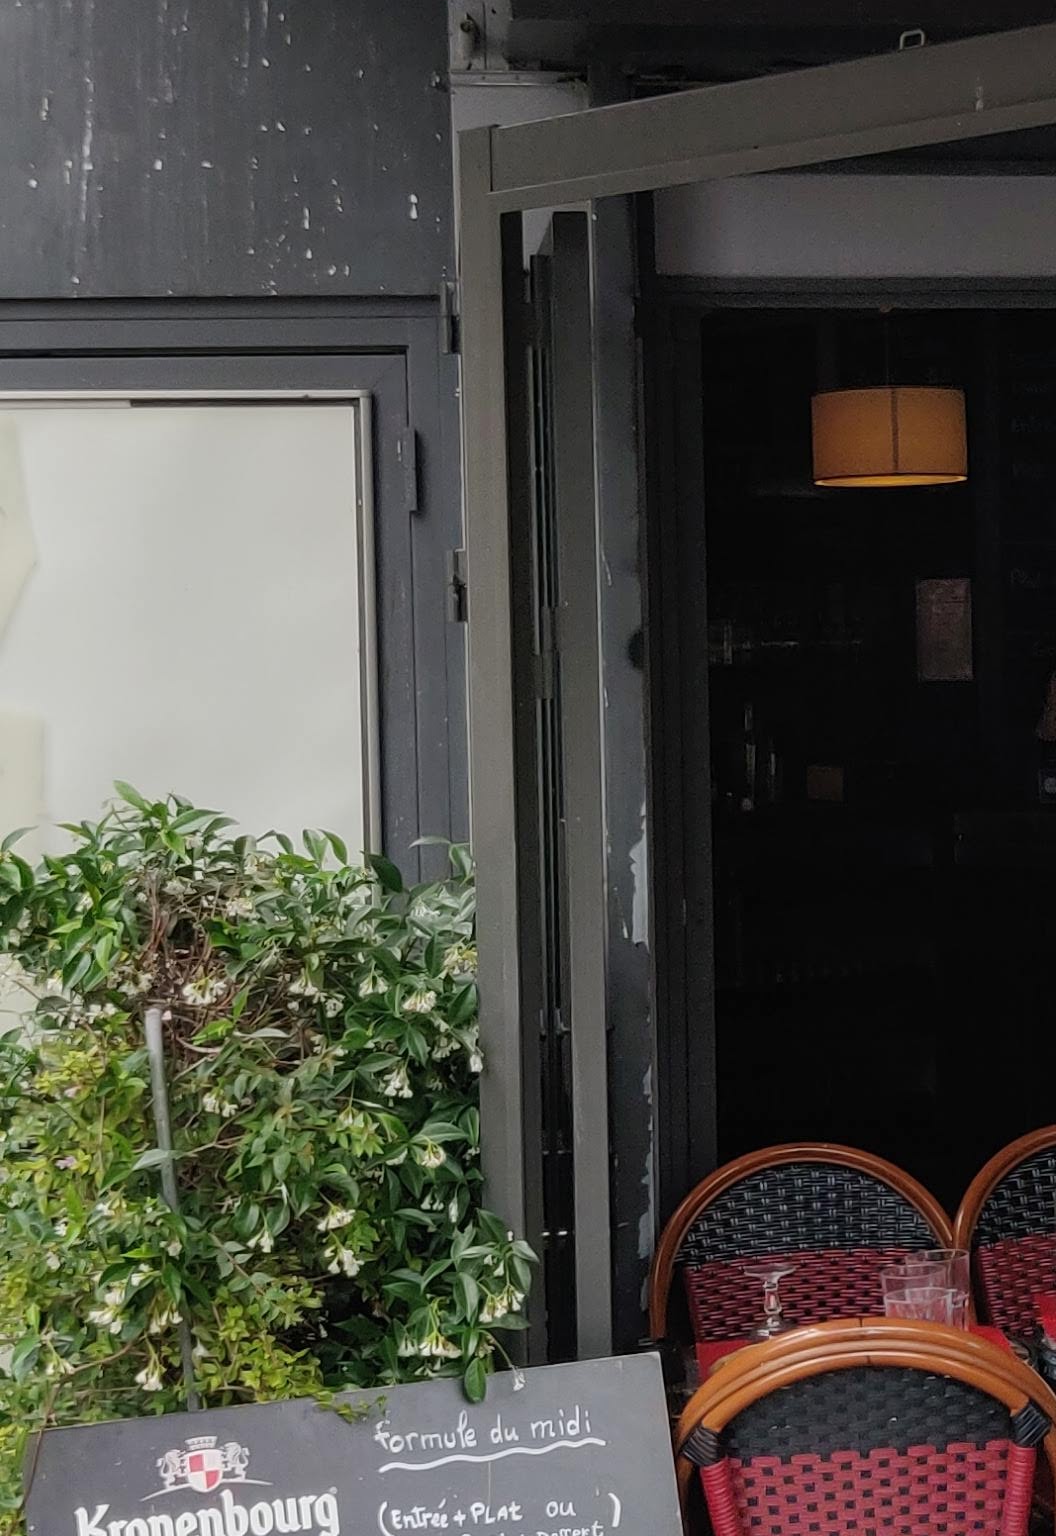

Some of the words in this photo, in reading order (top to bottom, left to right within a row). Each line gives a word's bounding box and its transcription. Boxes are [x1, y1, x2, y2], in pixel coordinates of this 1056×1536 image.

[373, 1410, 477, 1454] formule
[490, 1414, 519, 1444] du
[531, 1405, 591, 1439] midi
